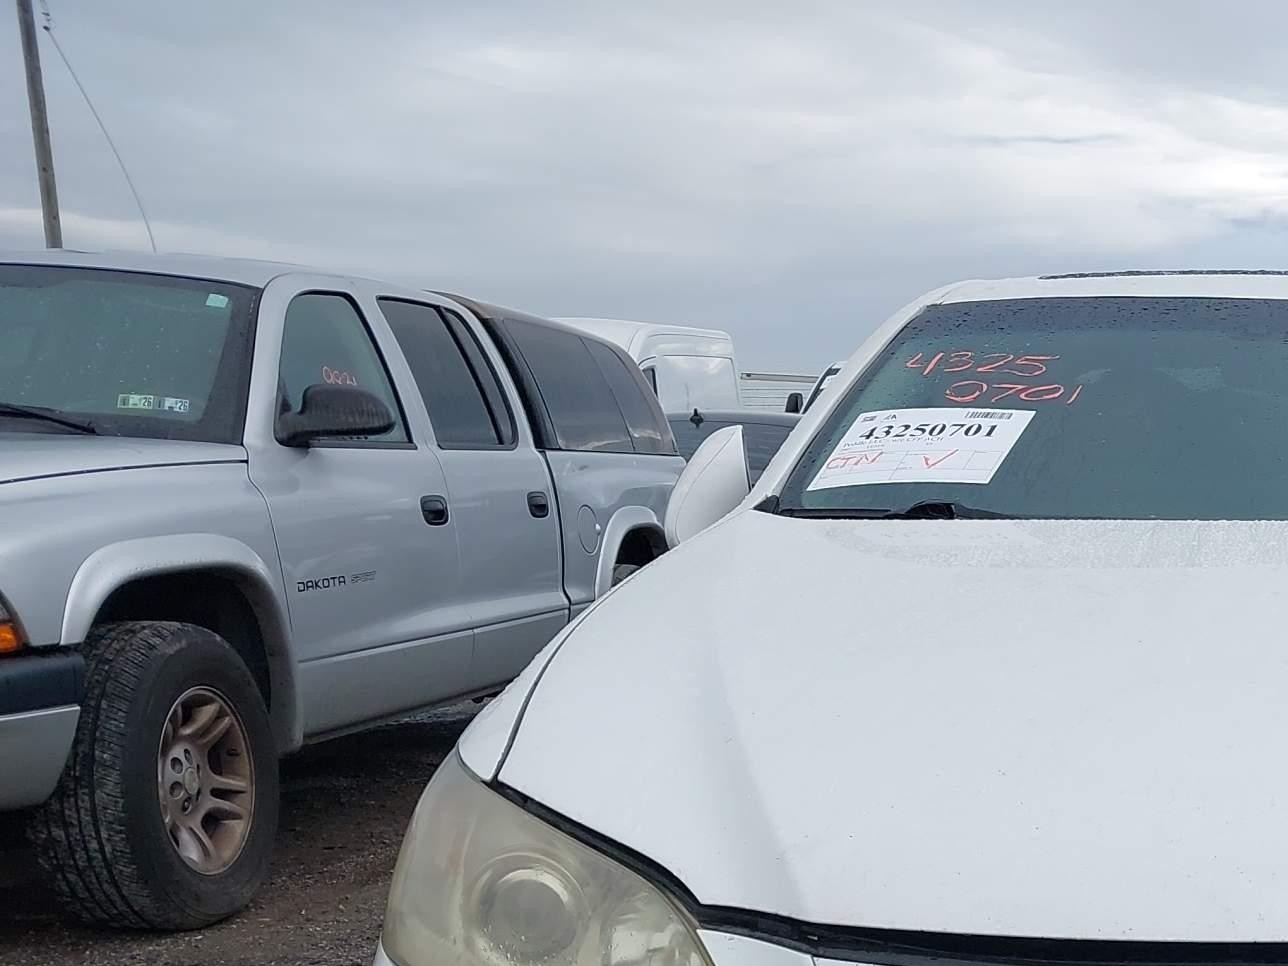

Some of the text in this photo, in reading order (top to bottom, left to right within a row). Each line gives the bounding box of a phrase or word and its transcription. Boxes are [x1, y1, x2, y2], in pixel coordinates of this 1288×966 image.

[906, 351, 1060, 377] 4325
[945, 380, 1083, 405] 0701
[858, 421, 999, 441] 43250701
[296, 575, 346, 593] DAKOTA
